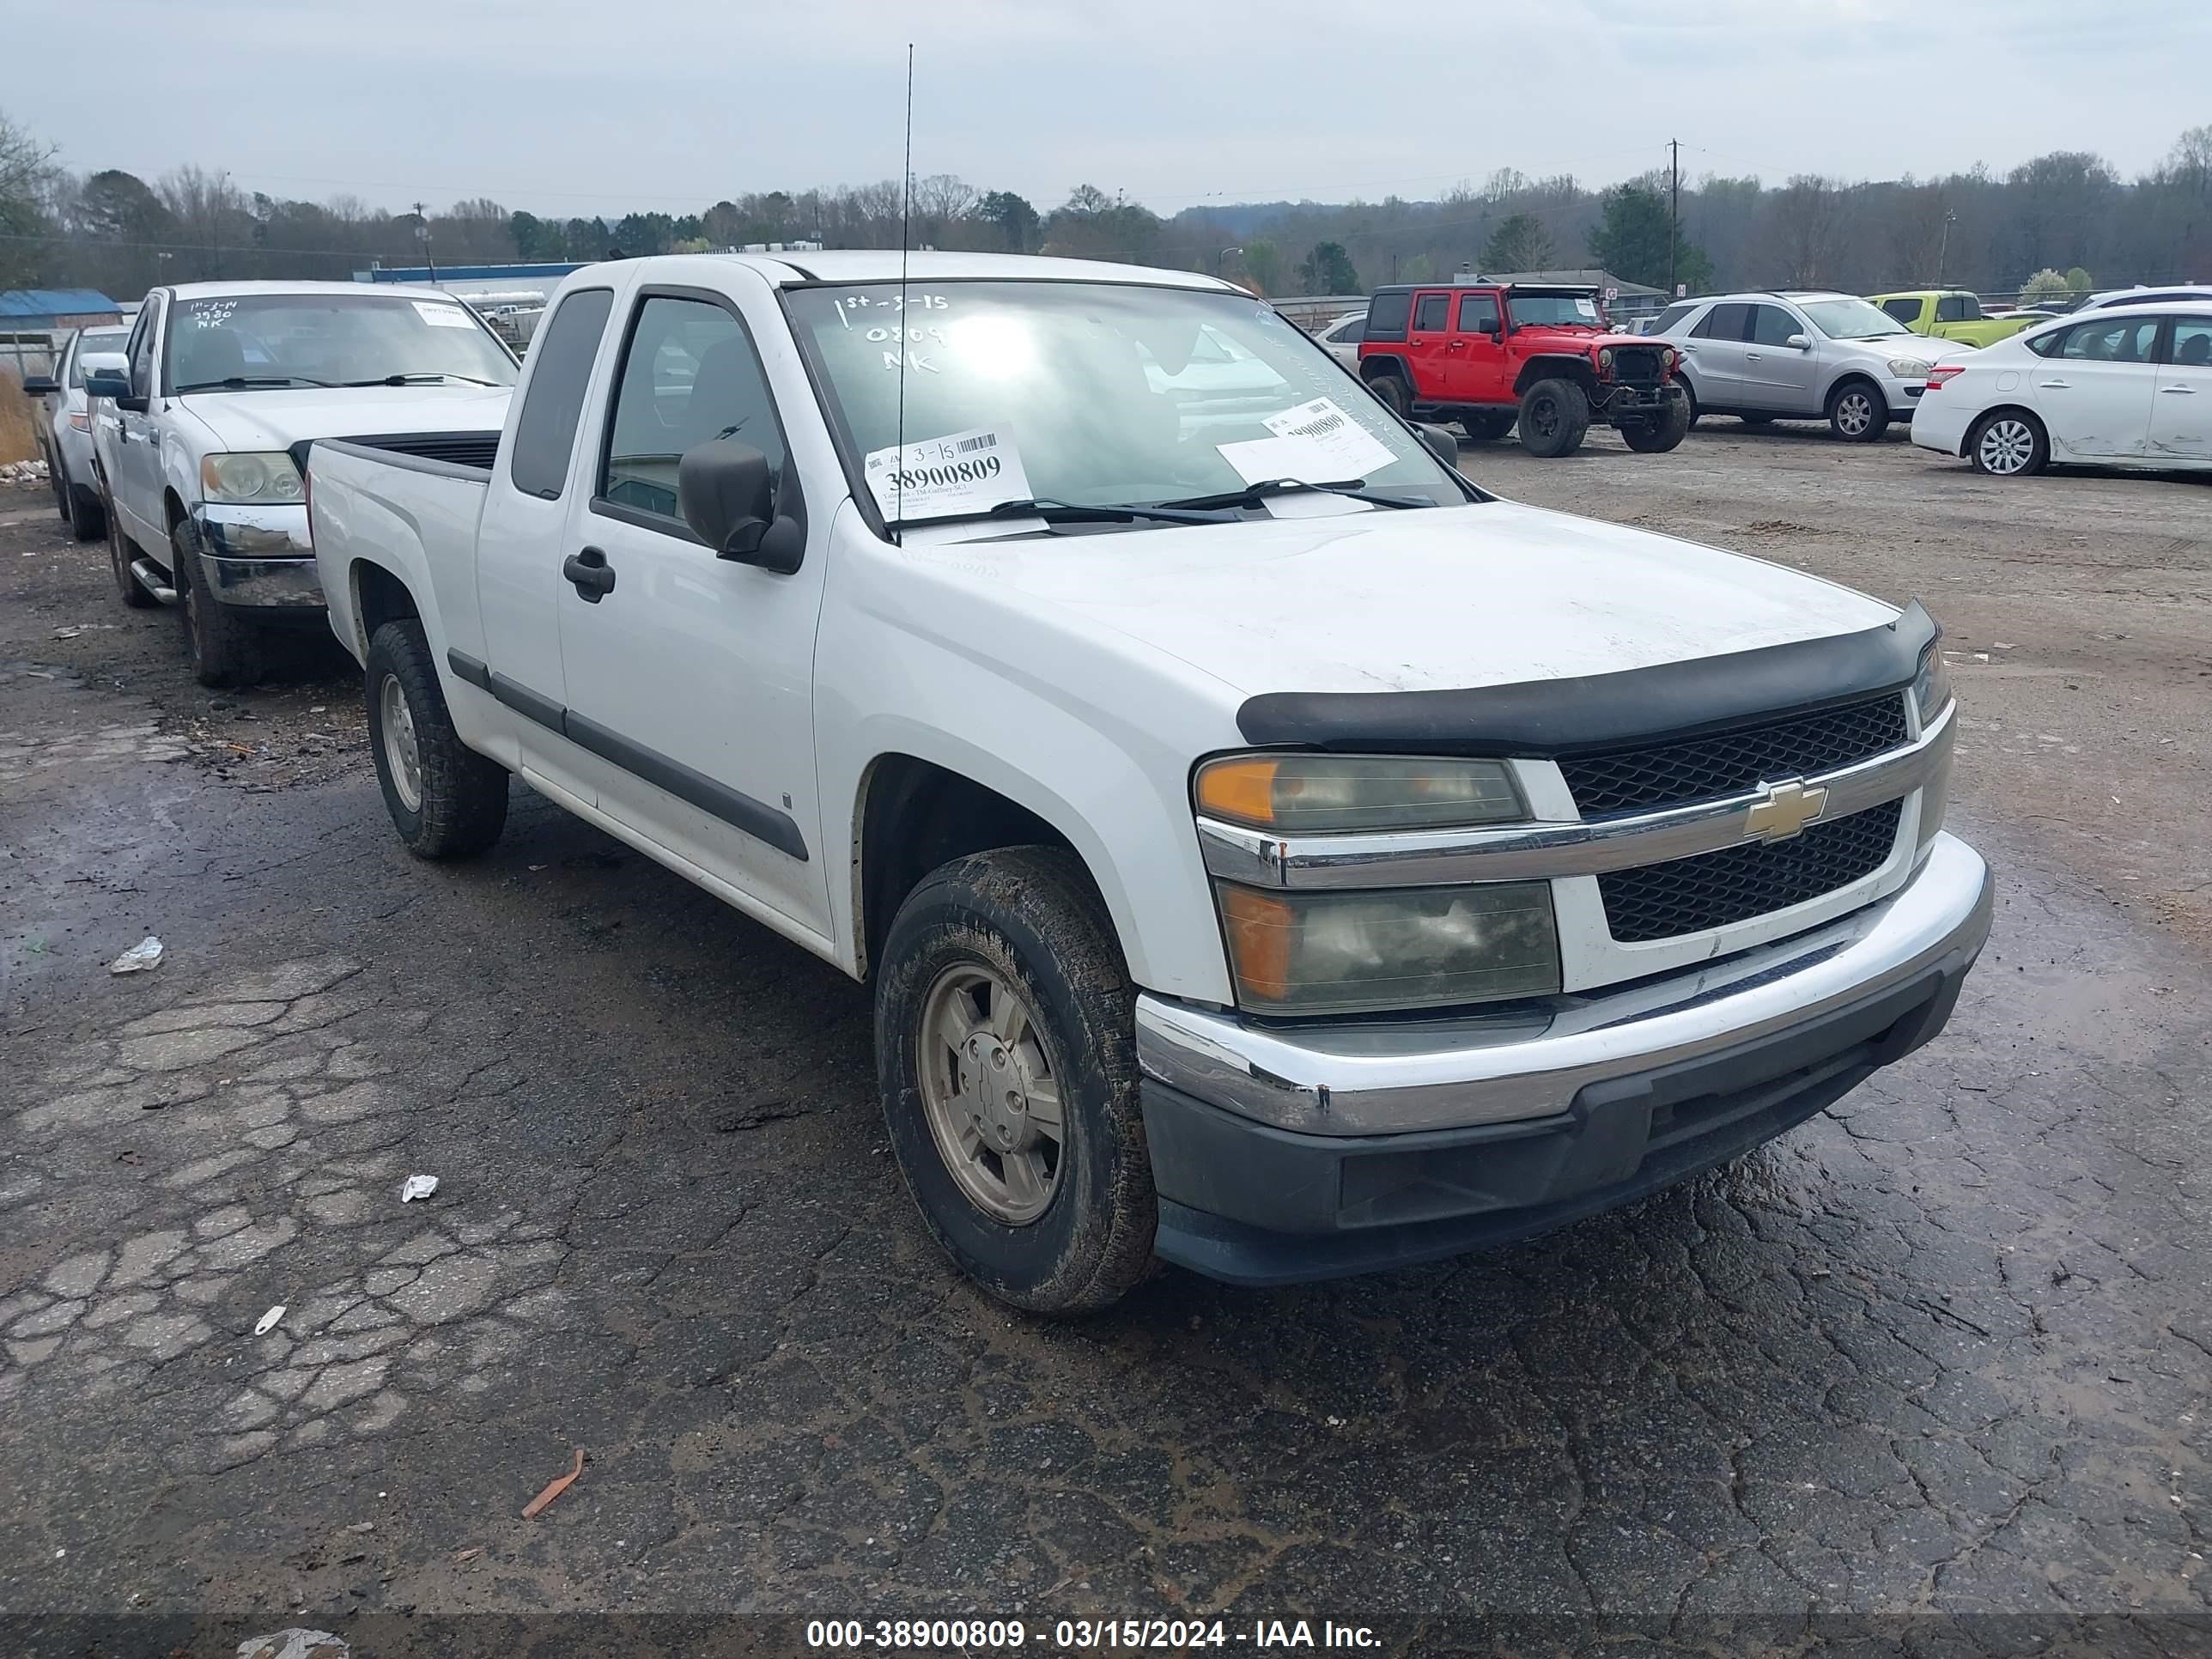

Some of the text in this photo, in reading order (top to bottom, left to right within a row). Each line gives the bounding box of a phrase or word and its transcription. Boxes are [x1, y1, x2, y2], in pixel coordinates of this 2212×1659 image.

[866, 326, 947, 348] 0809
[882, 350, 940, 374] NK
[914, 442, 955, 461] 3-15
[885, 456, 1000, 490] 38900809
